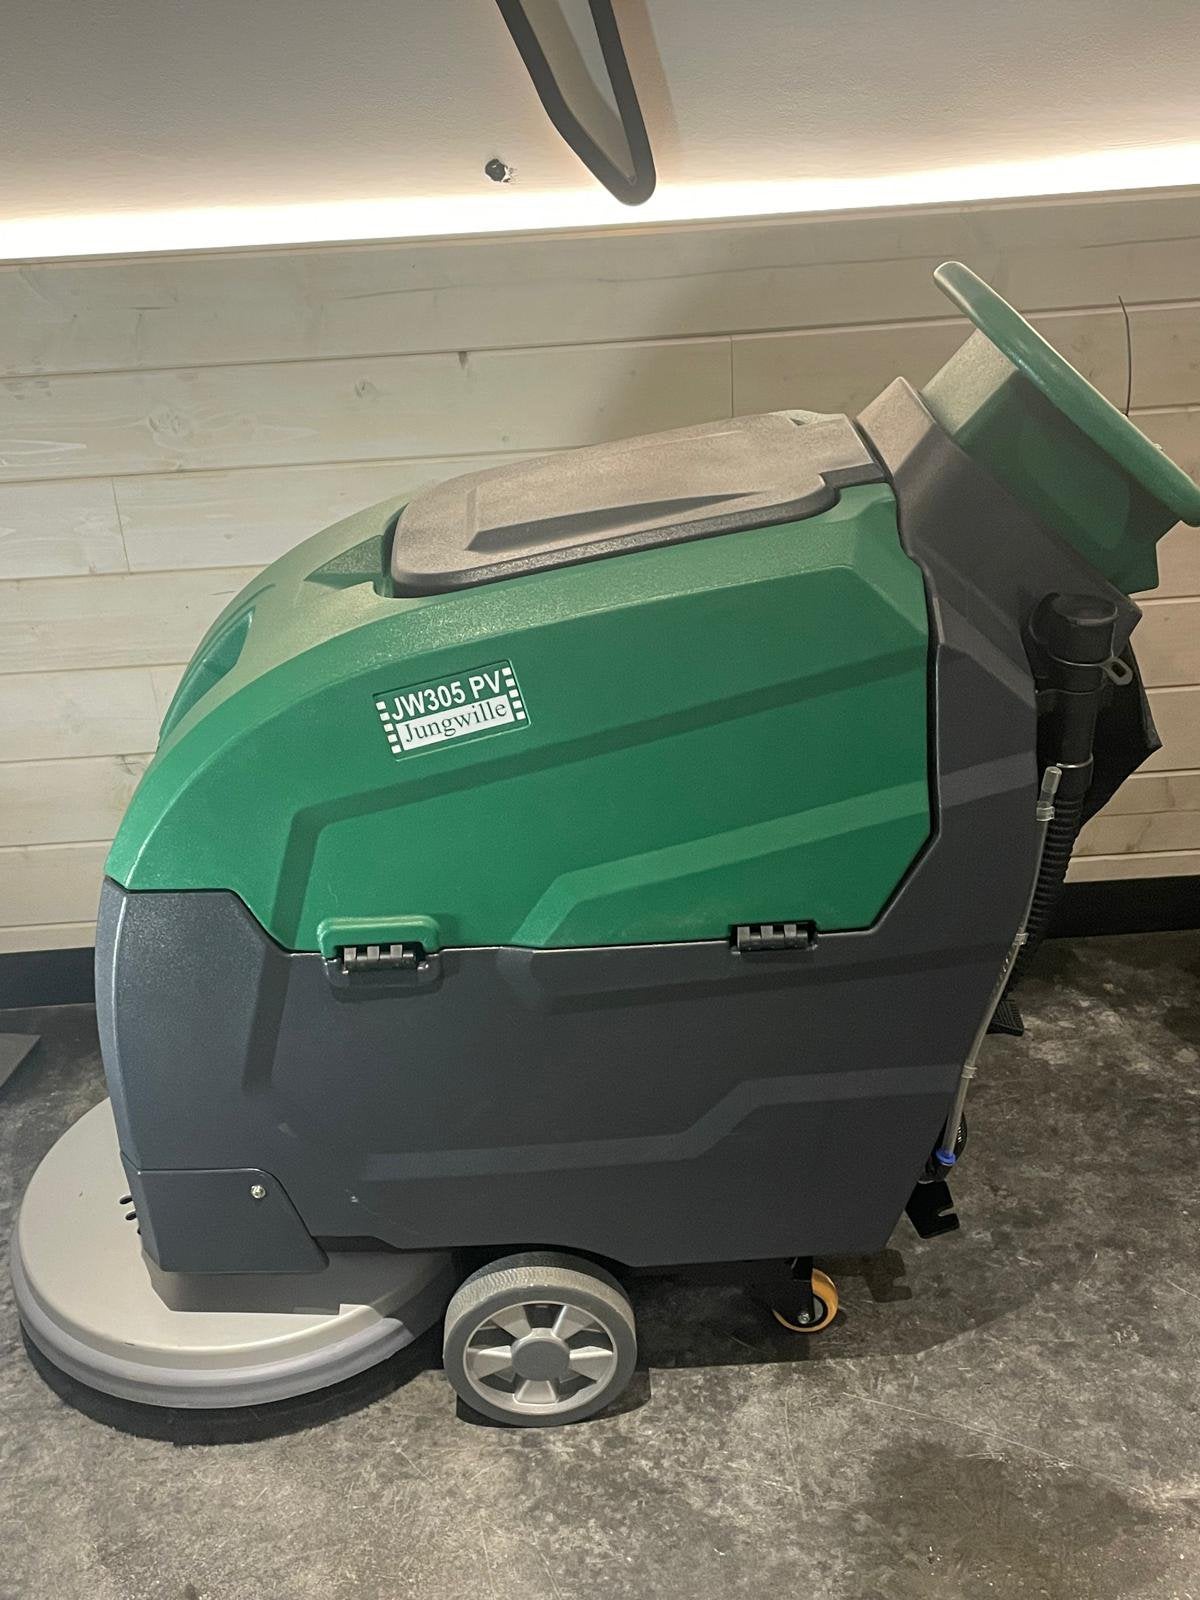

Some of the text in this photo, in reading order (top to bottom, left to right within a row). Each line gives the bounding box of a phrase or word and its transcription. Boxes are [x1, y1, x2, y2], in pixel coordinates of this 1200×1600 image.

[391, 670, 500, 721] JW305 PV
[405, 701, 507, 742] Jungwille
